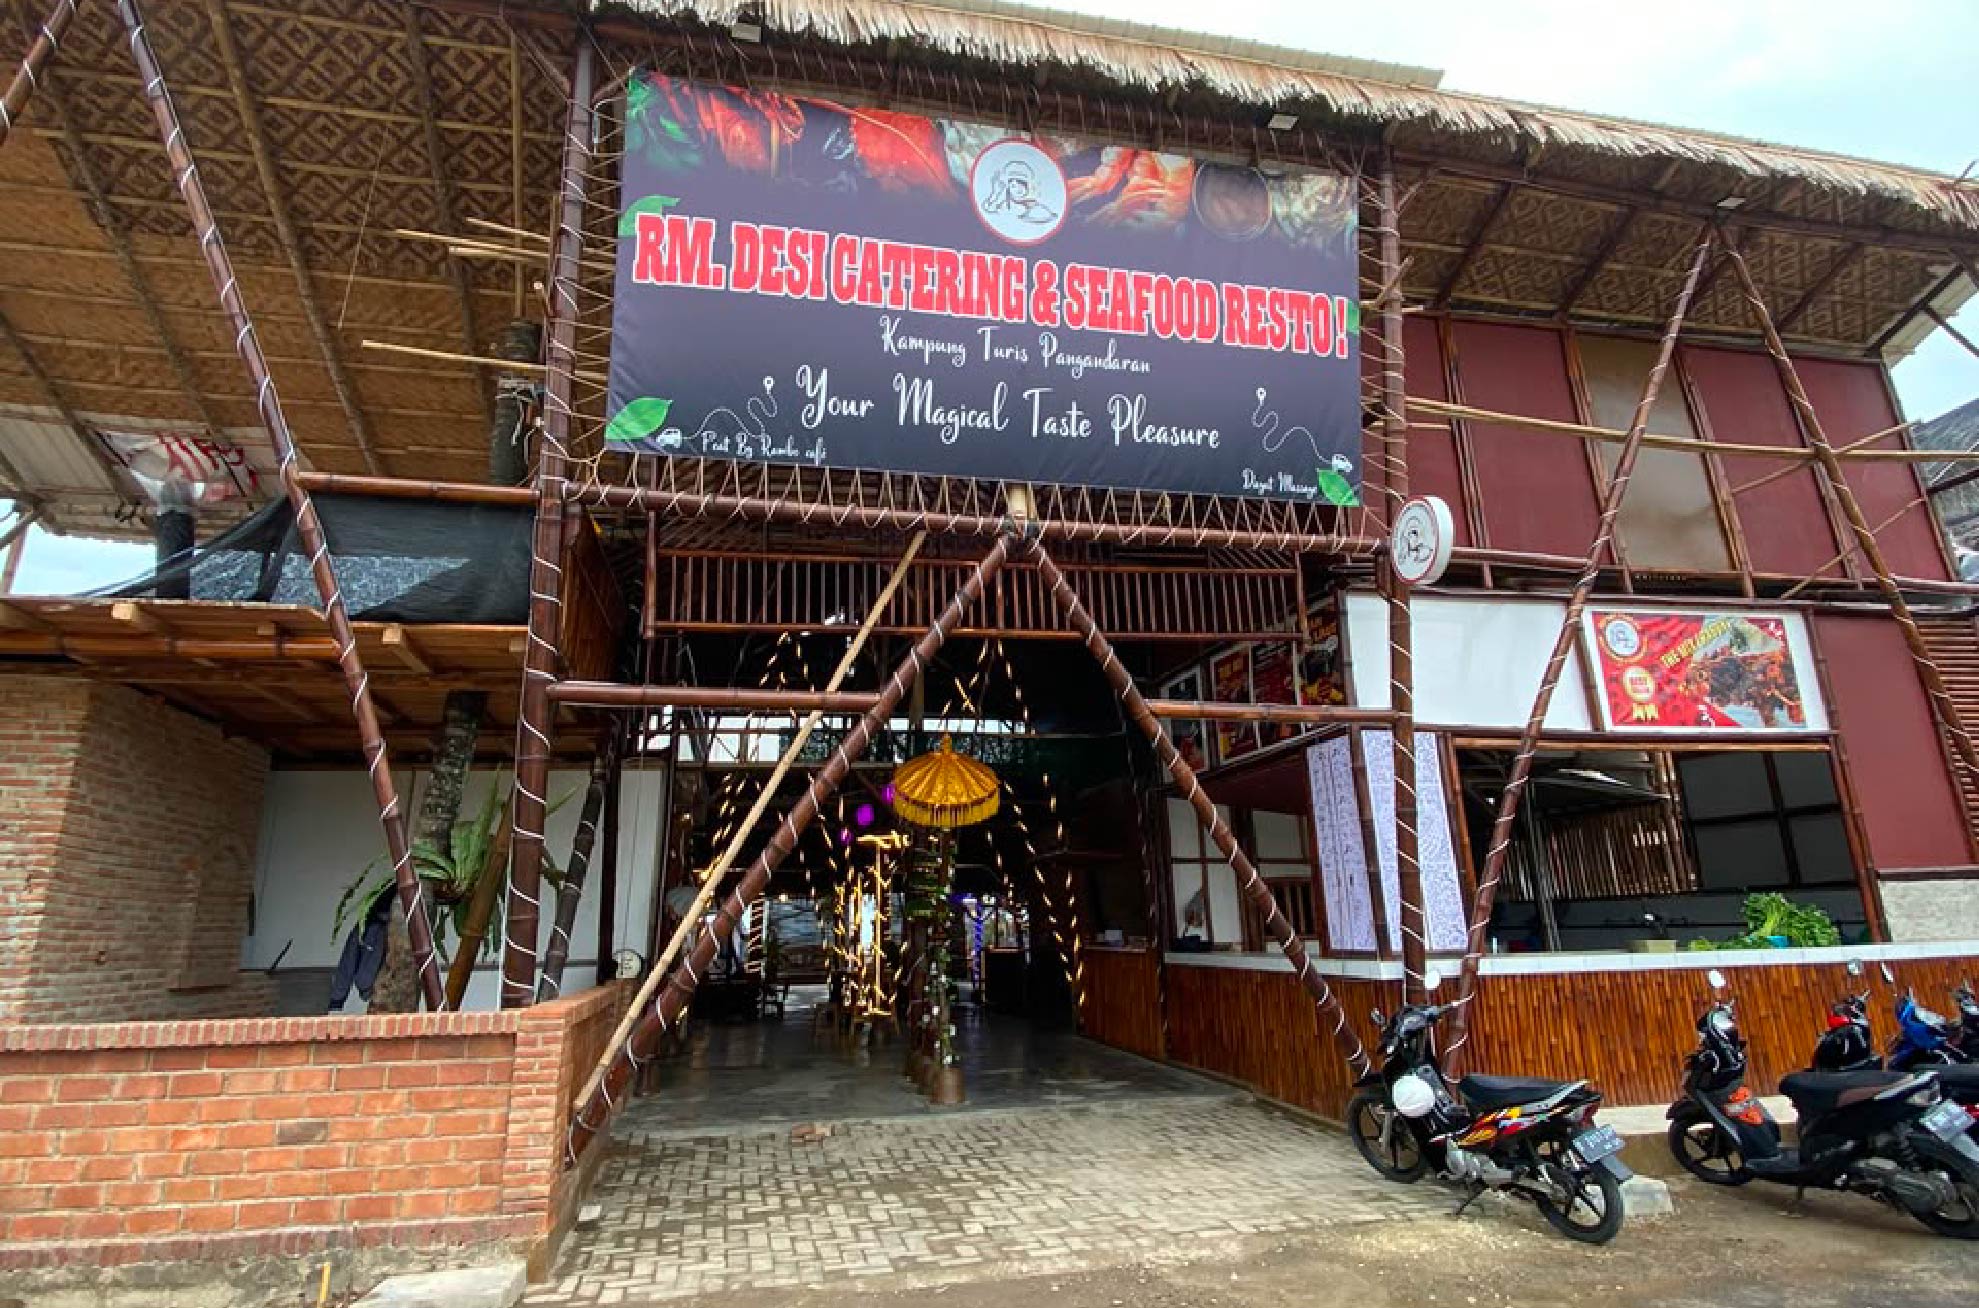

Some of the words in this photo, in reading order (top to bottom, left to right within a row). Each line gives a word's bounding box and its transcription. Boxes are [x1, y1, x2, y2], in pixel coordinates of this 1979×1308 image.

[633, 212, 727, 289] RM.
[730, 221, 830, 301] DESI
[832, 232, 1027, 323] CATERING
[1030, 259, 1060, 328] &
[1063, 261, 1218, 343] SEAFOOD
[879, 314, 967, 368] Kampung
[976, 325, 1028, 362] Turis
[1038, 331, 1151, 379] Pangandaran
[795, 364, 875, 430] Your
[892, 372, 1010, 445] Magical
[1022, 387, 1093, 438] Taste
[1106, 393, 1221, 449] Pleasure
